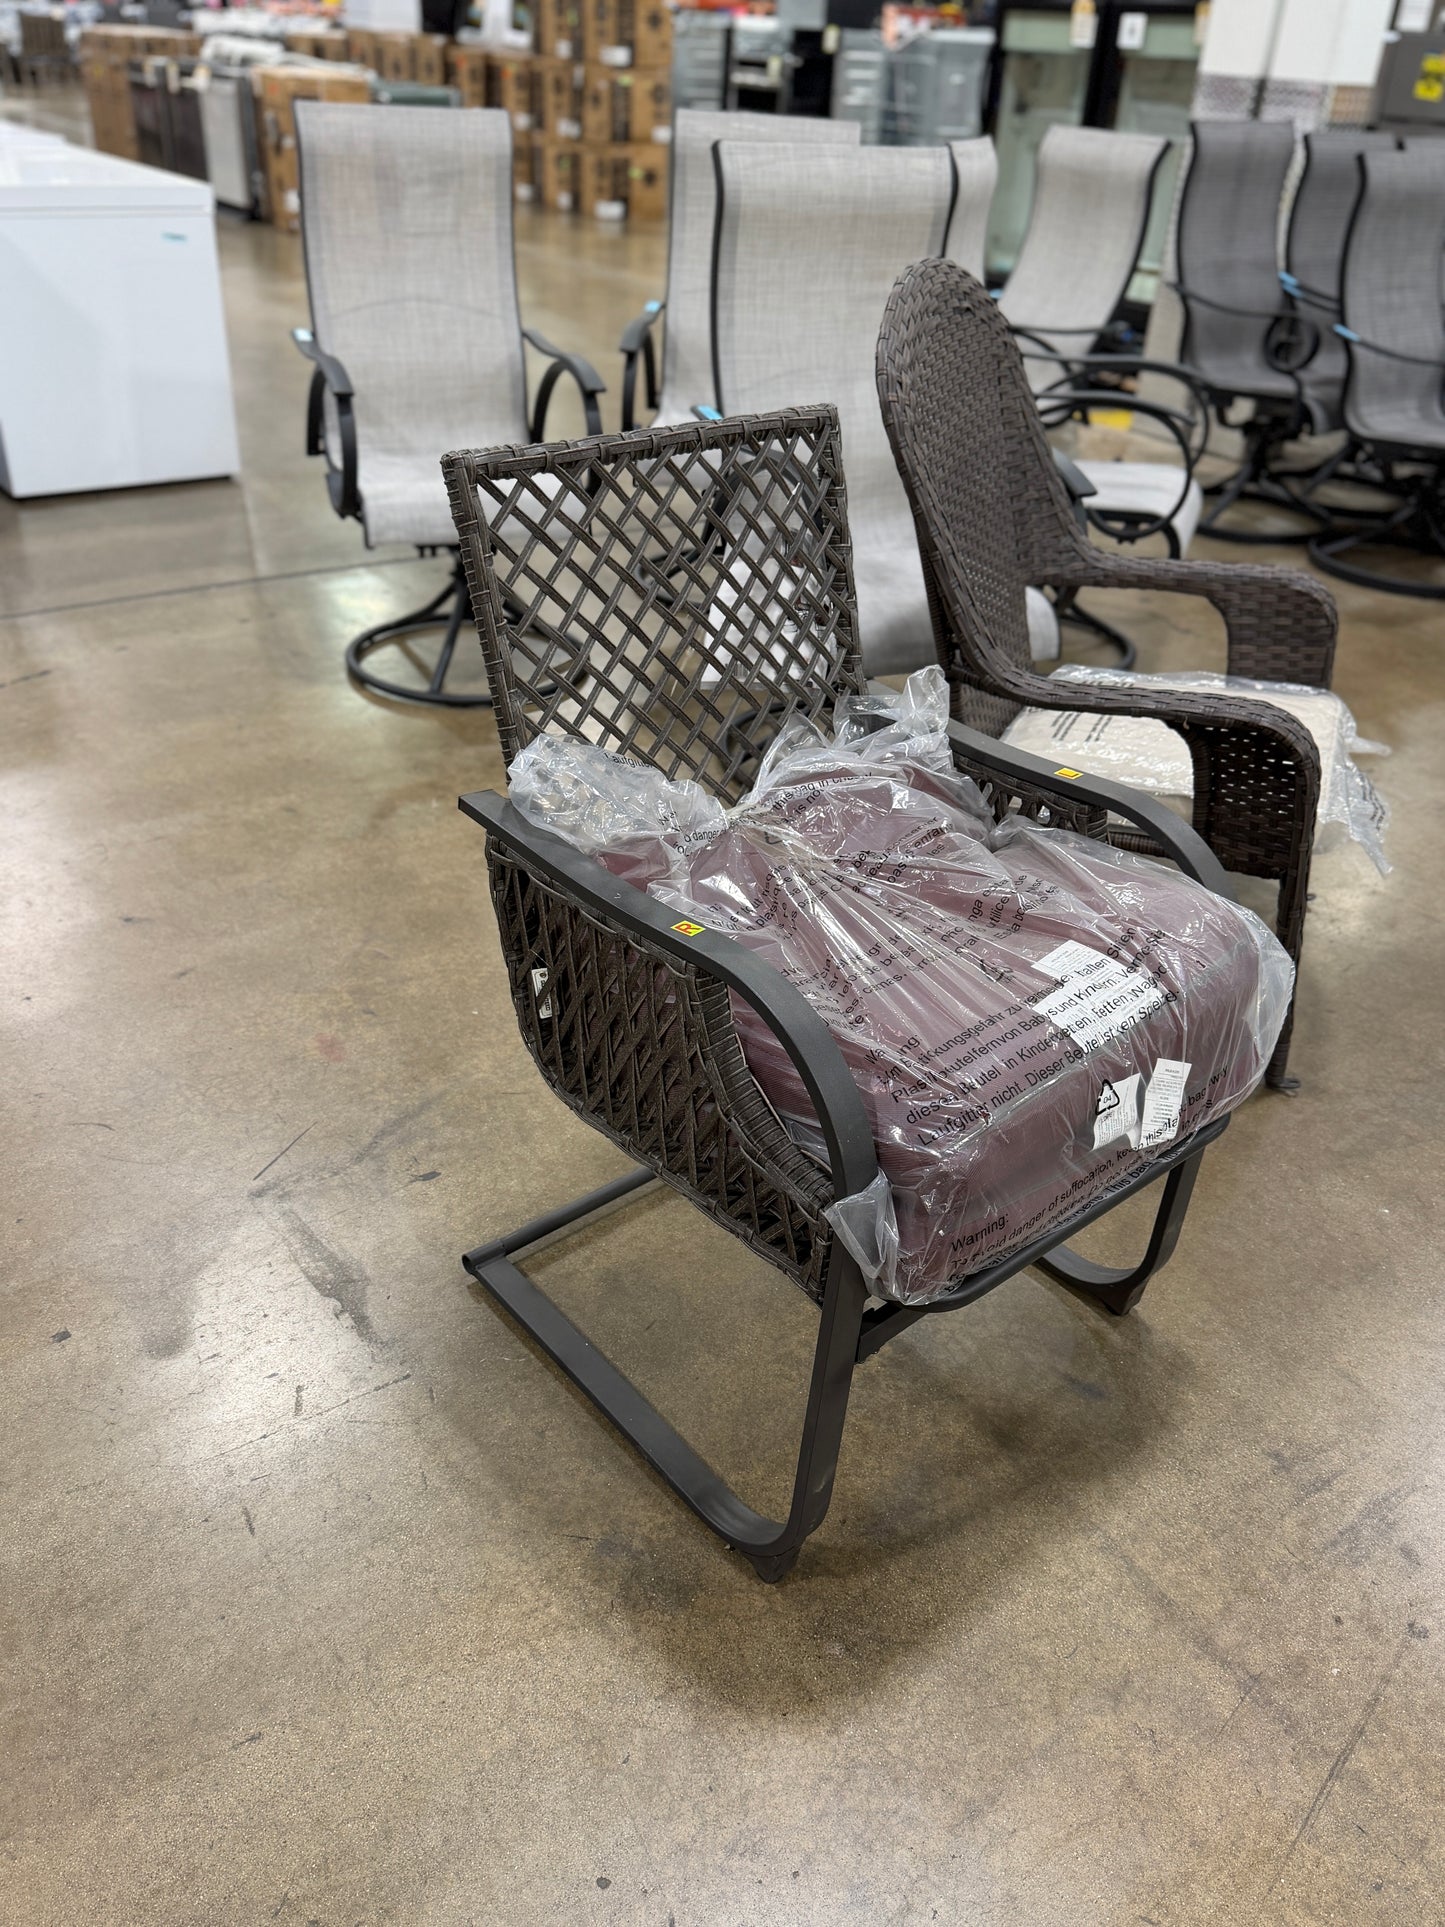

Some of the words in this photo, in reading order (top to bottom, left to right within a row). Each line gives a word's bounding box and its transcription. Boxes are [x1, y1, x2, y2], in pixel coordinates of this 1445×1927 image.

[674, 923, 700, 936] R
[1005, 1003, 1022, 1016] zu
[1002, 1057, 1019, 1070] in
[917, 1101, 990, 1147] Laufgitter
[990, 1081, 1027, 1109] nicht.
[1024, 1056, 1066, 1087] Dieser
[1064, 1033, 1103, 1064] Beutel
[1101, 1026, 1116, 1044] ist
[1008, 1207, 1047, 1241] danger
[1048, 1194, 1061, 1213] of
[1060, 1159, 1115, 1204] suffocation,
[951, 1213, 1010, 1252] Warning:
